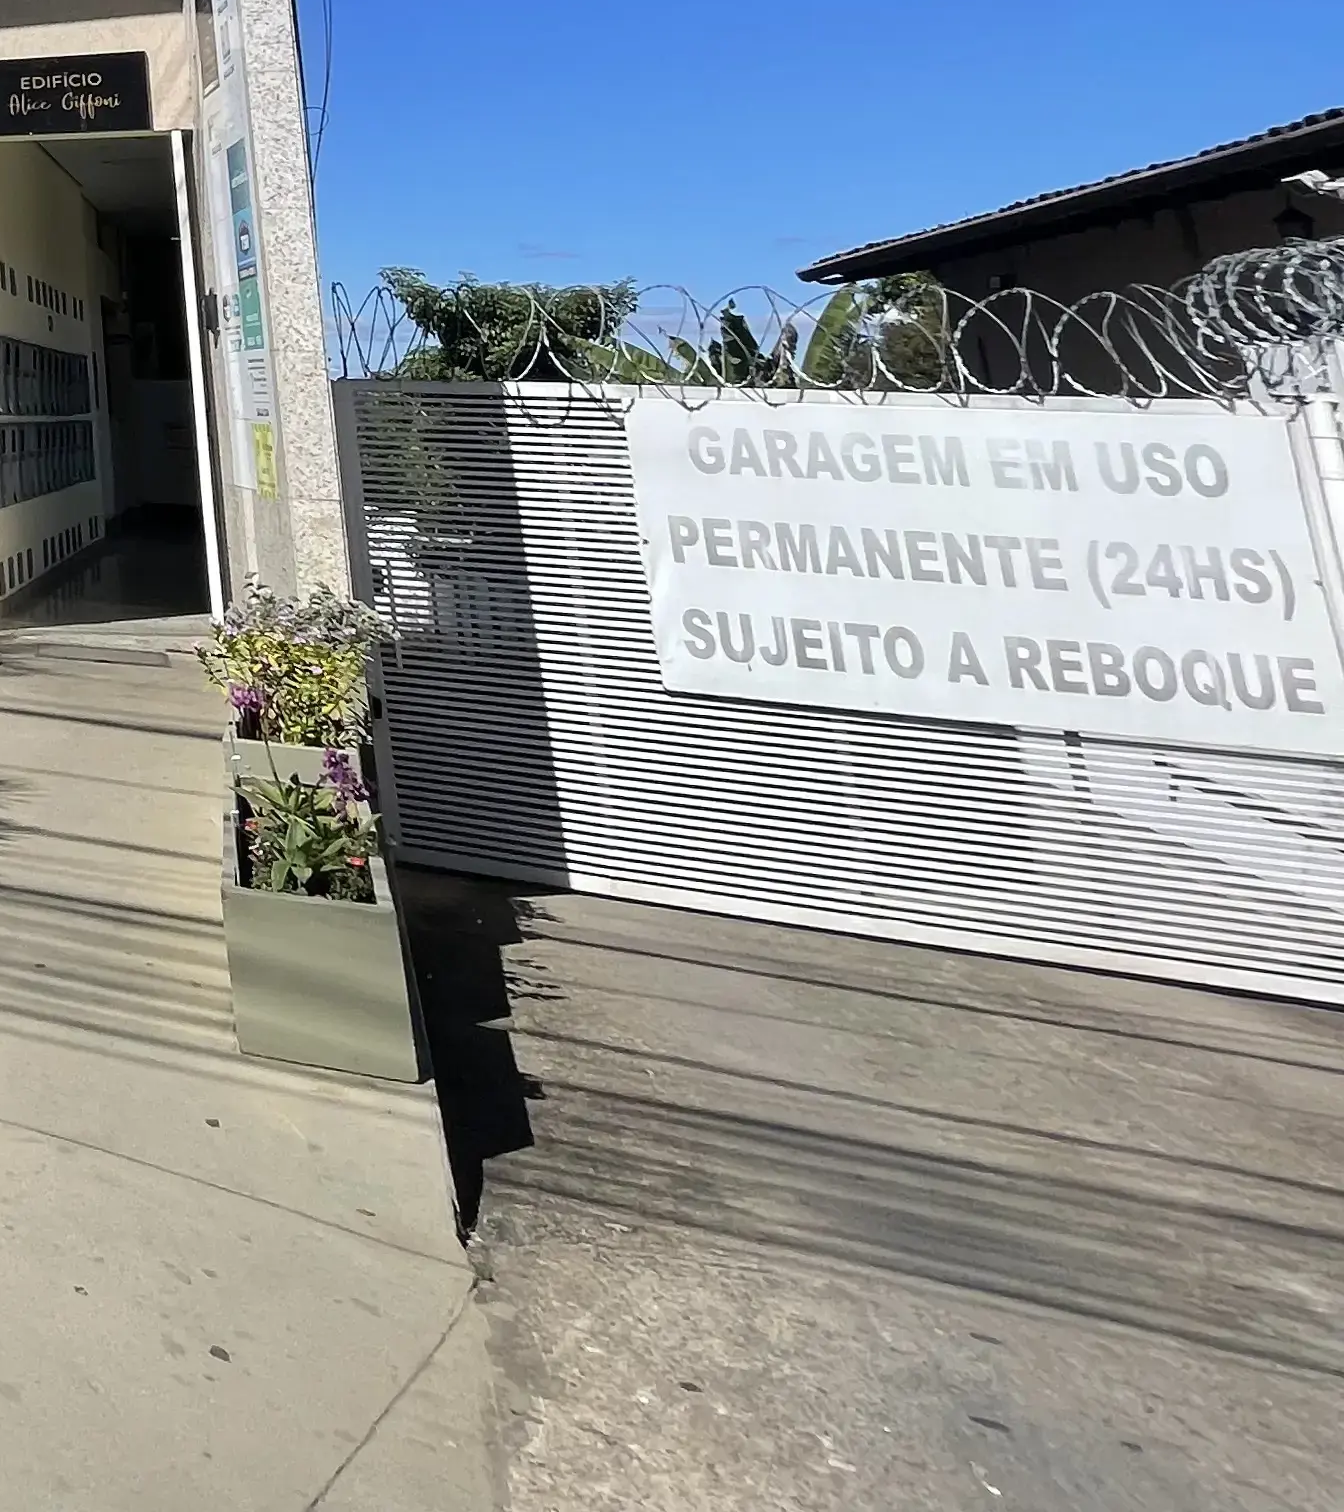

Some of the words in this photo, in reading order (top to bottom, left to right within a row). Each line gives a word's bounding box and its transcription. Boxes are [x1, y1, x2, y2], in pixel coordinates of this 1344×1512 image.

[9, 93, 51, 116] Alice
[20, 71, 102, 90] EDIFÍCIO
[687, 425, 971, 489] GARAGEM
[988, 436, 1079, 493] EM
[1098, 440, 1229, 499] USO
[668, 514, 1070, 592] PERMANENTE
[1087, 538, 1298, 621] (24HS)
[681, 607, 925, 680] SUJEITO
[946, 631, 990, 686] A
[1004, 635, 1326, 715] REBOQUE
